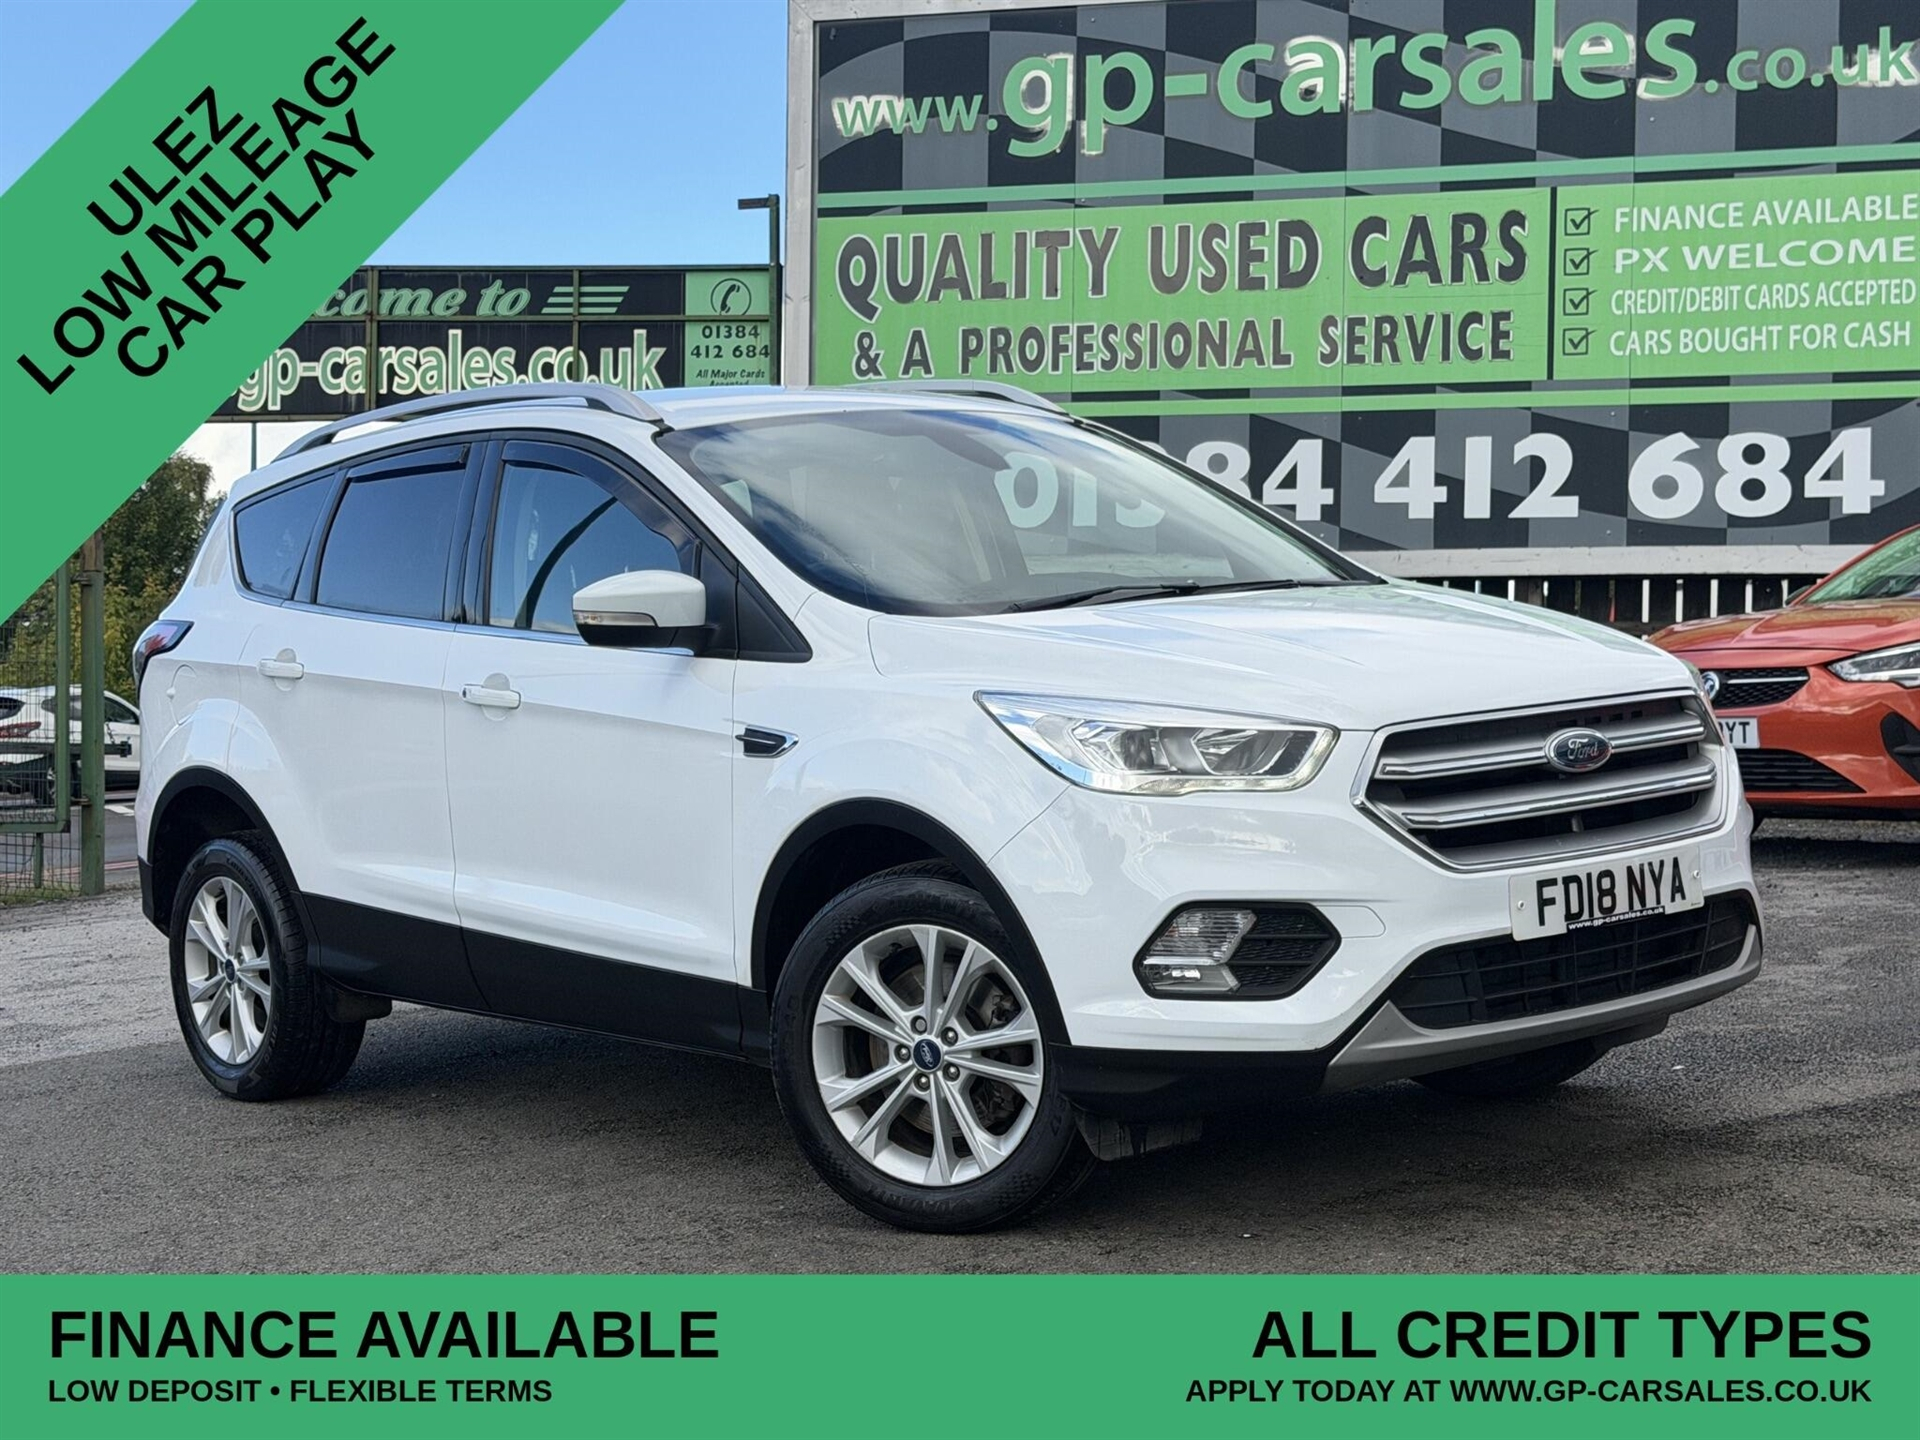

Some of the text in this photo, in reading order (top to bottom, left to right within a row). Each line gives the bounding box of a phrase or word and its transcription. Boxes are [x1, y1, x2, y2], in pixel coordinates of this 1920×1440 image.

[834, 0, 1918, 158] www.gp-carsales.co.uk
[1614, 193, 1919, 233] FINANCE AVAILABLE
[837, 210, 1529, 322] QUALITY USED CARS
[1614, 235, 1917, 274] PX WELCOME
[476, 279, 531, 317] to
[1611, 278, 1917, 315] CREDIT/DEBIT CARDS ACCEPTED
[702, 325, 760, 339] 01384
[852, 309, 1515, 379] & A PROFESSIONAL SERVICE
[1609, 321, 1911, 356] CARS BOUGHT FOR CASH
[690, 345, 770, 359] 412 684
[696, 369, 709, 379] All
[710, 369, 738, 380] Major
[1374, 432, 1580, 520] 412
[1628, 427, 1885, 520] 684
[1567, 738, 1600, 760] Ford
[1536, 857, 1687, 927] FD18 NYA
[1568, 906, 1664, 930] www.gp-carsales.co.uk
